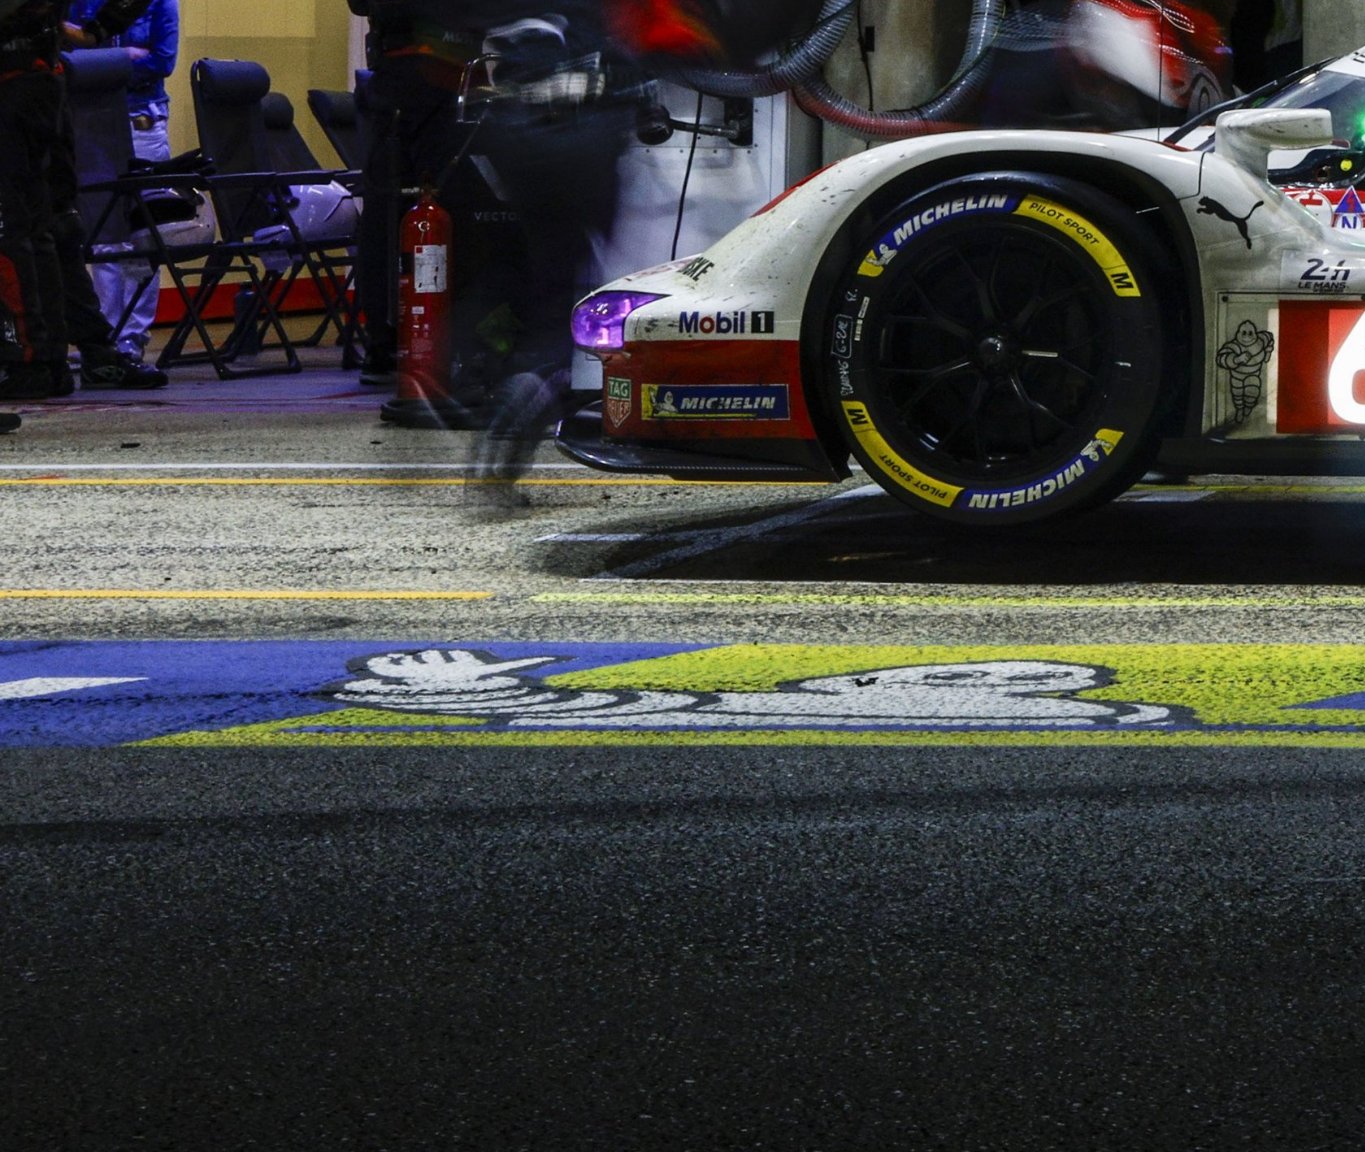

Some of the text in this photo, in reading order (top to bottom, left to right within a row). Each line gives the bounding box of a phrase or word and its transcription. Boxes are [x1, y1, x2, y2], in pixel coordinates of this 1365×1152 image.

[474, 211, 520, 221] VECTO
[893, 194, 1134, 290] MICHELIN PILOT SPORT M
[1299, 281, 1346, 289] LE MANS
[678, 311, 745, 334] Mobil
[608, 381, 629, 397] TAG
[680, 397, 776, 410] MICHELIN
[846, 407, 1086, 509] MICHELIN PILOT SPORT M
